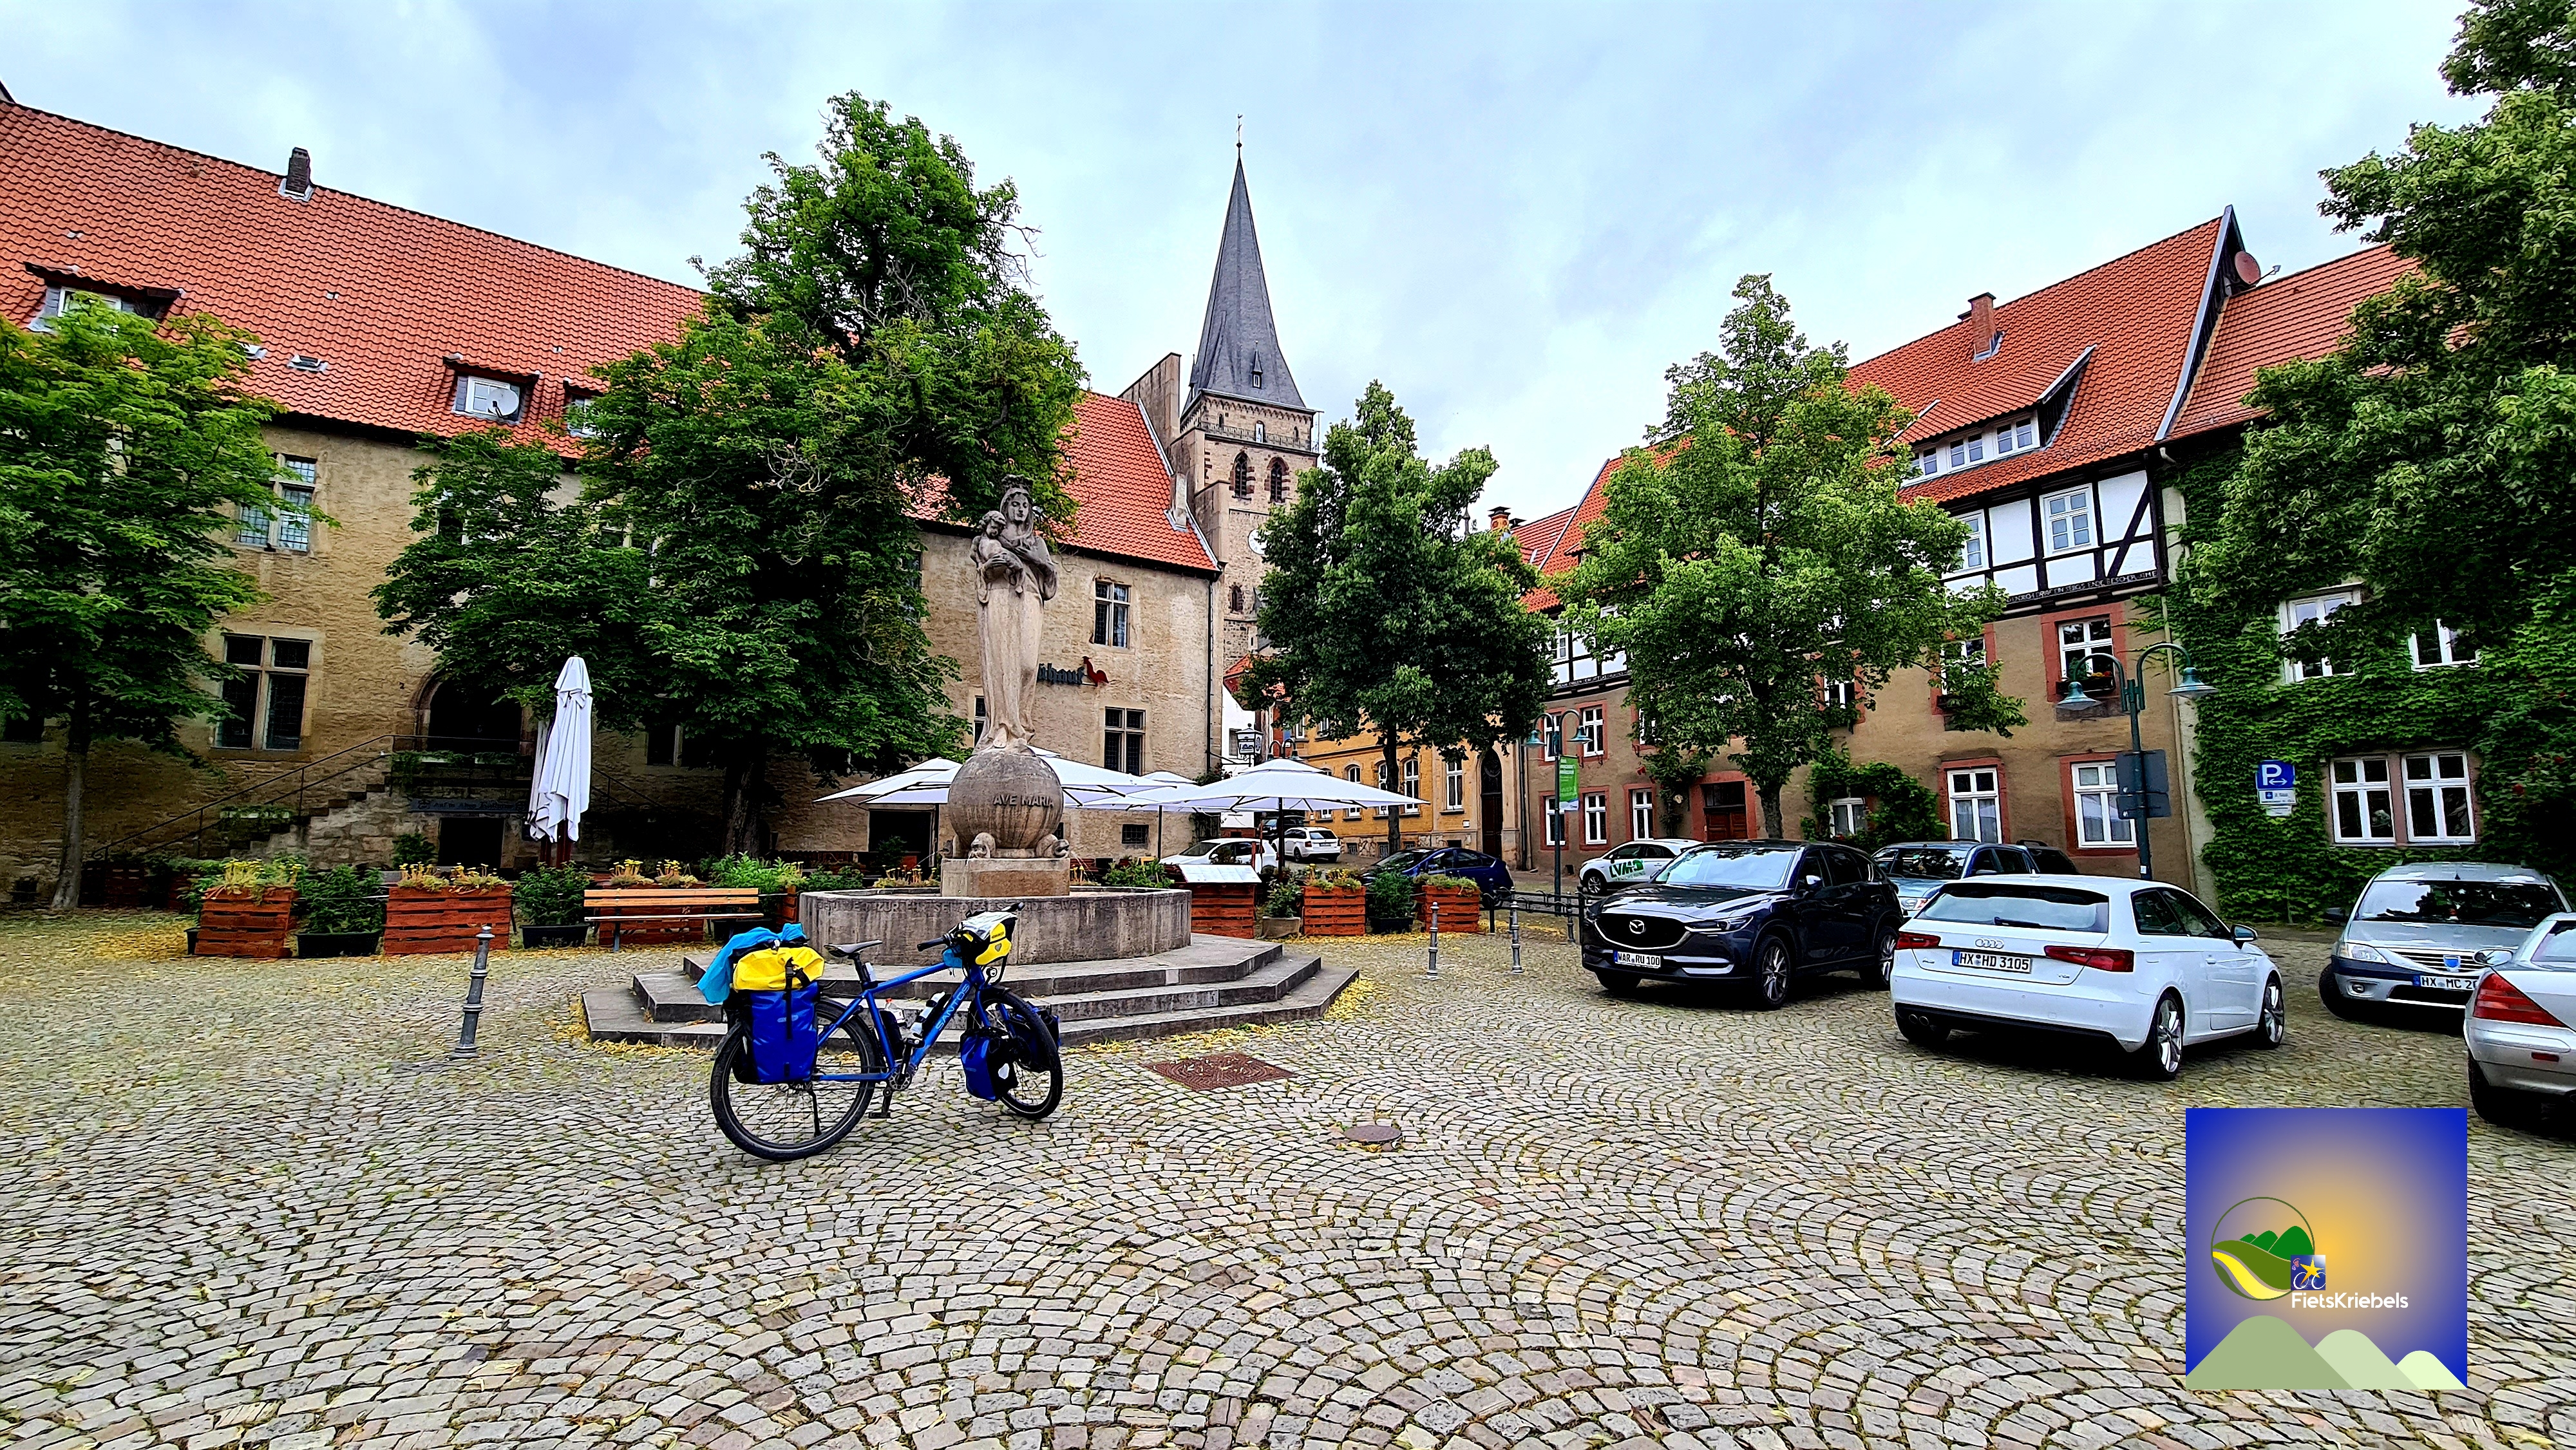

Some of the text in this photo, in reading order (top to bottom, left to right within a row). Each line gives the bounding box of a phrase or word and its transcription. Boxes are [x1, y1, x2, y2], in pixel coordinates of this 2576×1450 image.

[2261, 764, 2282, 786] P
[992, 794, 1054, 807] AVE MARIA
[1618, 952, 1660, 966] WAR RU 100
[1959, 952, 2030, 971] HX HD 3105
[2421, 977, 2437, 987] HX
[2445, 978, 2462, 988] MC
[936, 983, 970, 1031] SANTOS
